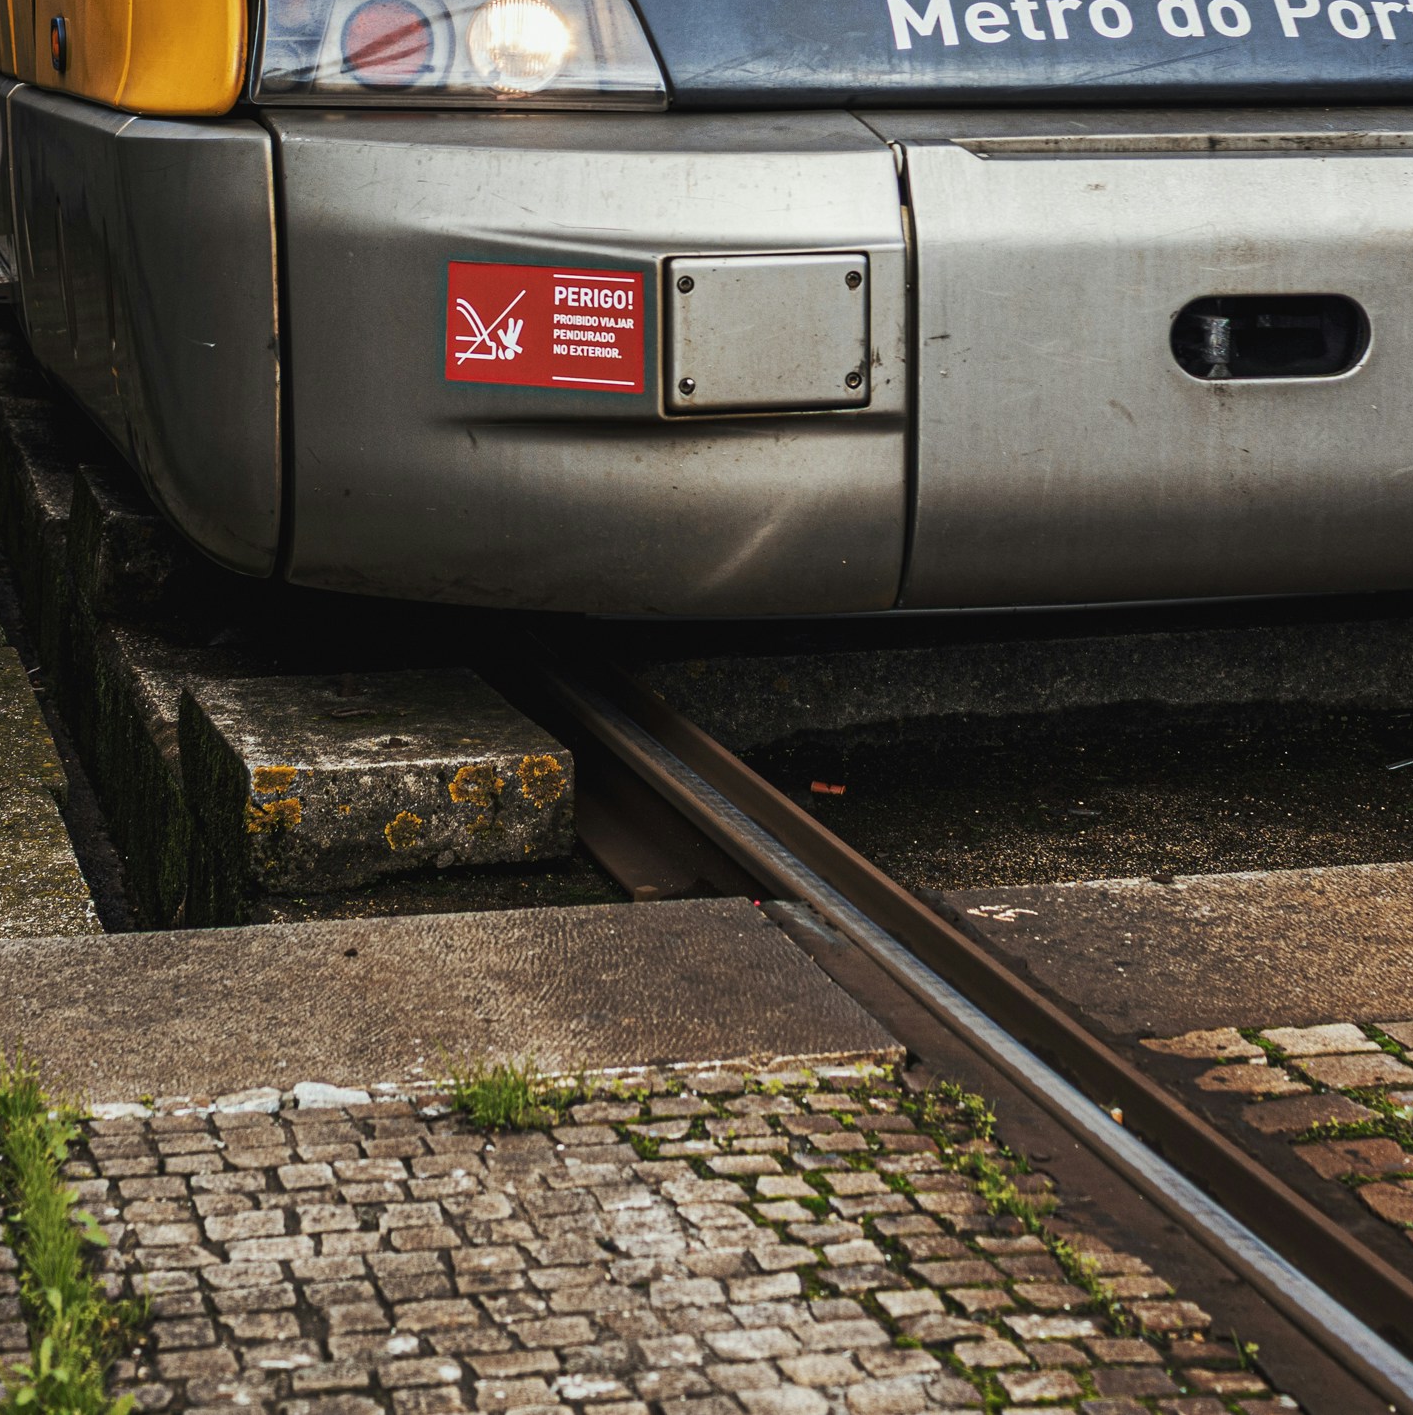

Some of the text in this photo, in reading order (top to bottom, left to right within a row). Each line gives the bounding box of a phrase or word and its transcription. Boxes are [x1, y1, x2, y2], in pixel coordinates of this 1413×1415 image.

[554, 285, 634, 310] PERIGO!
[553, 313, 634, 329] PROIBIDO VIAJAR
[553, 328, 616, 343] PENDURADO
[553, 343, 622, 359] NO EXTERIOR.
